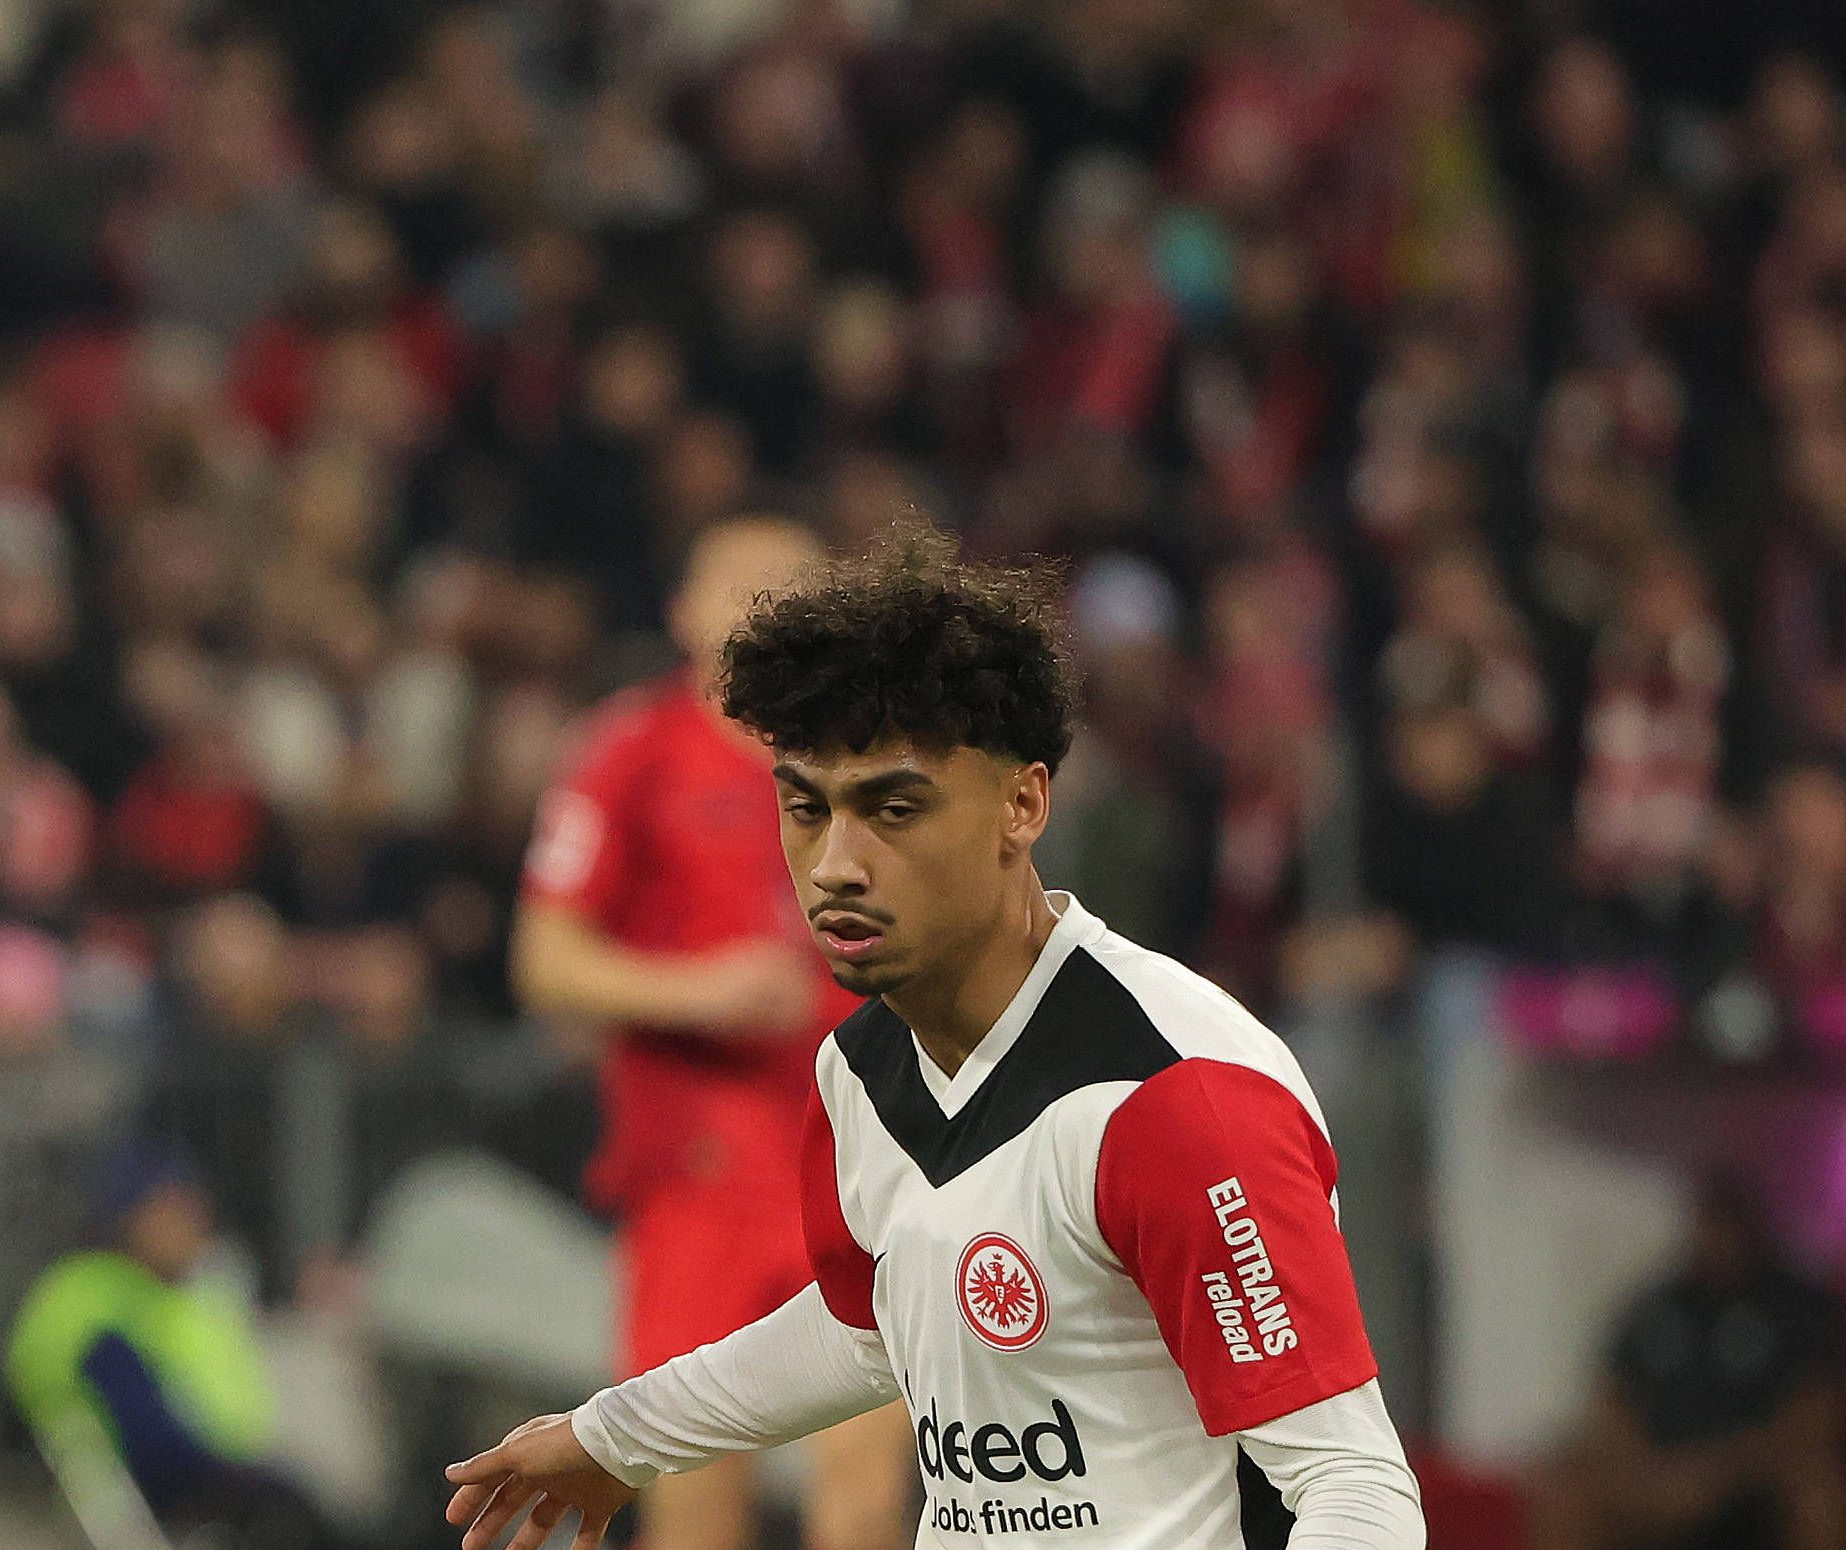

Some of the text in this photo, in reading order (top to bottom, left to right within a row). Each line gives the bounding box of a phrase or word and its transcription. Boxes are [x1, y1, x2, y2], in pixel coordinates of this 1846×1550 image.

[1206, 1176, 1299, 1357] ELOTRANS
[1201, 1271, 1265, 1364] reload
[917, 1396, 1087, 1484] deed
[979, 1496, 1099, 1535] finden
